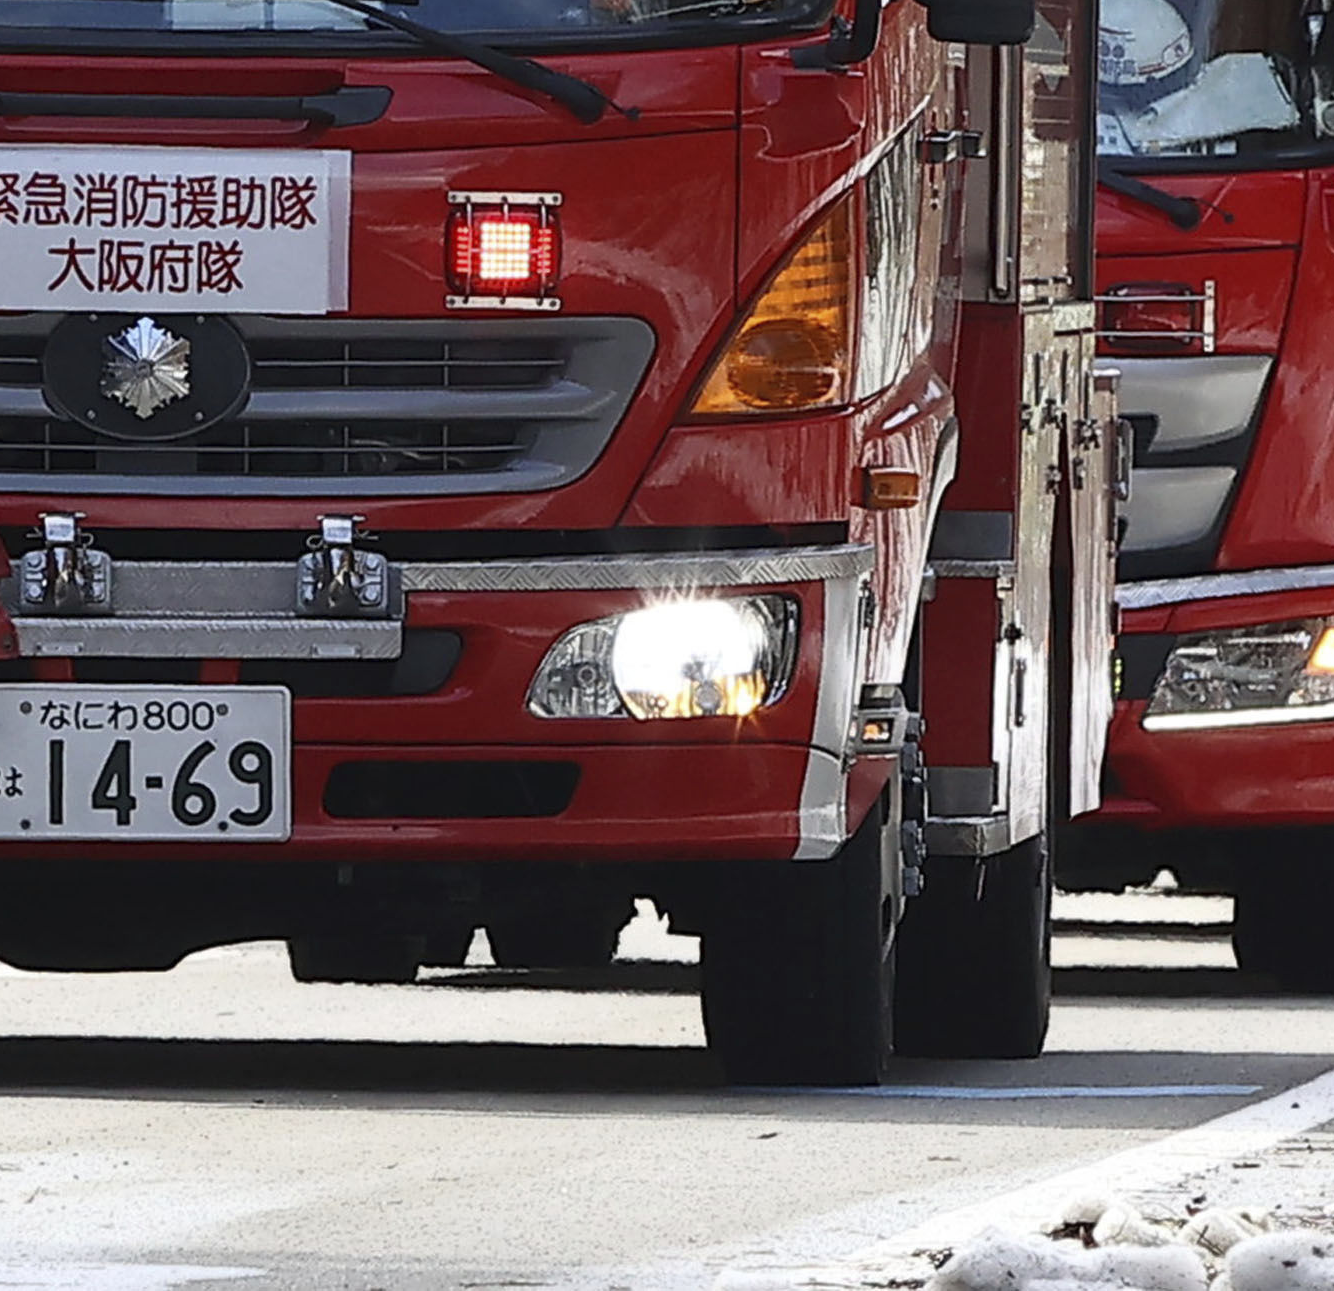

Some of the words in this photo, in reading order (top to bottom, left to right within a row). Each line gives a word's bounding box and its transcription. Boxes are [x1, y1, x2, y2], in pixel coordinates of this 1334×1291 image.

[47, 238, 244, 295] 大阪府隊
[39, 700, 215, 731] なにわ800
[49, 739, 273, 826] 14-69
